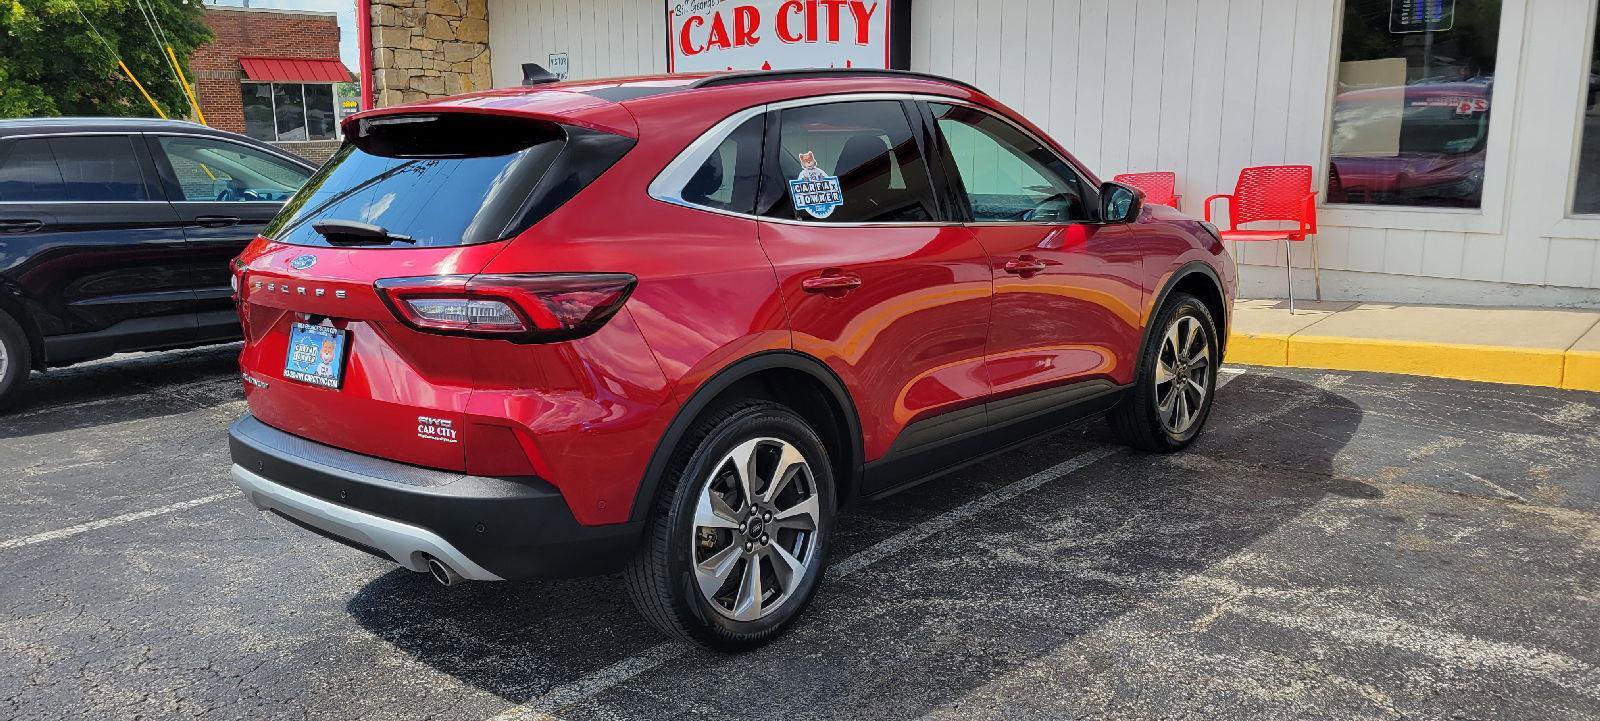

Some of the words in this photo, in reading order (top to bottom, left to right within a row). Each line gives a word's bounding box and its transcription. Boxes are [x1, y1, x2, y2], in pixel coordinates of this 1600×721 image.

[690, 0, 720, 15] George
[679, 6, 761, 56] CAR
[774, 0, 878, 45] CITY
[793, 181, 839, 193] CARFAX
[804, 192, 840, 204] OWNER
[255, 281, 347, 299] ESCAPE
[418, 425, 436, 435] CAR
[436, 427, 457, 439] CITY
